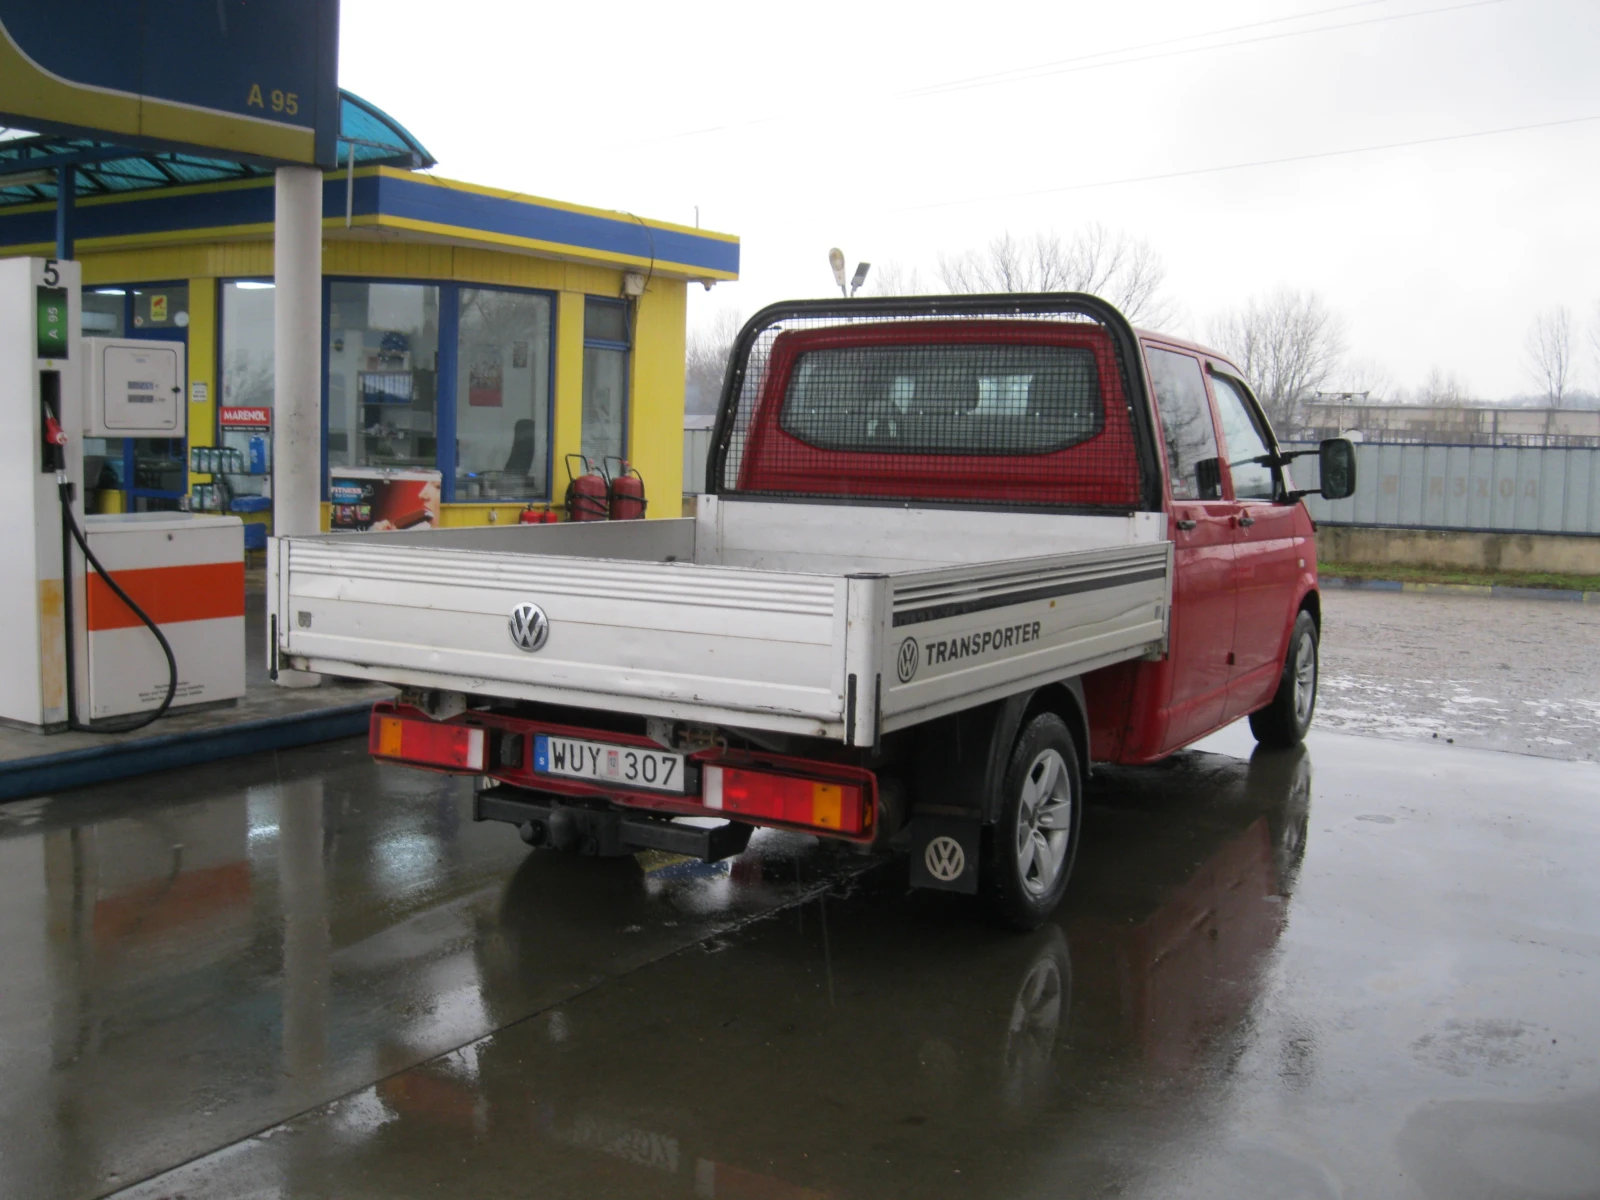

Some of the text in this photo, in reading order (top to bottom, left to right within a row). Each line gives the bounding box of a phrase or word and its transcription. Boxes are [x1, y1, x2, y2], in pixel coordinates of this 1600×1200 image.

[248, 84, 299, 116] A 95
[44, 259, 60, 286] 5
[47, 306, 59, 340] A 95
[223, 409, 267, 421] MARENOL
[331, 486, 362, 494] FITNESS
[926, 621, 1041, 666] TRANSPORTER
[538, 757, 545, 765] S
[552, 741, 677, 786] WUY 307
